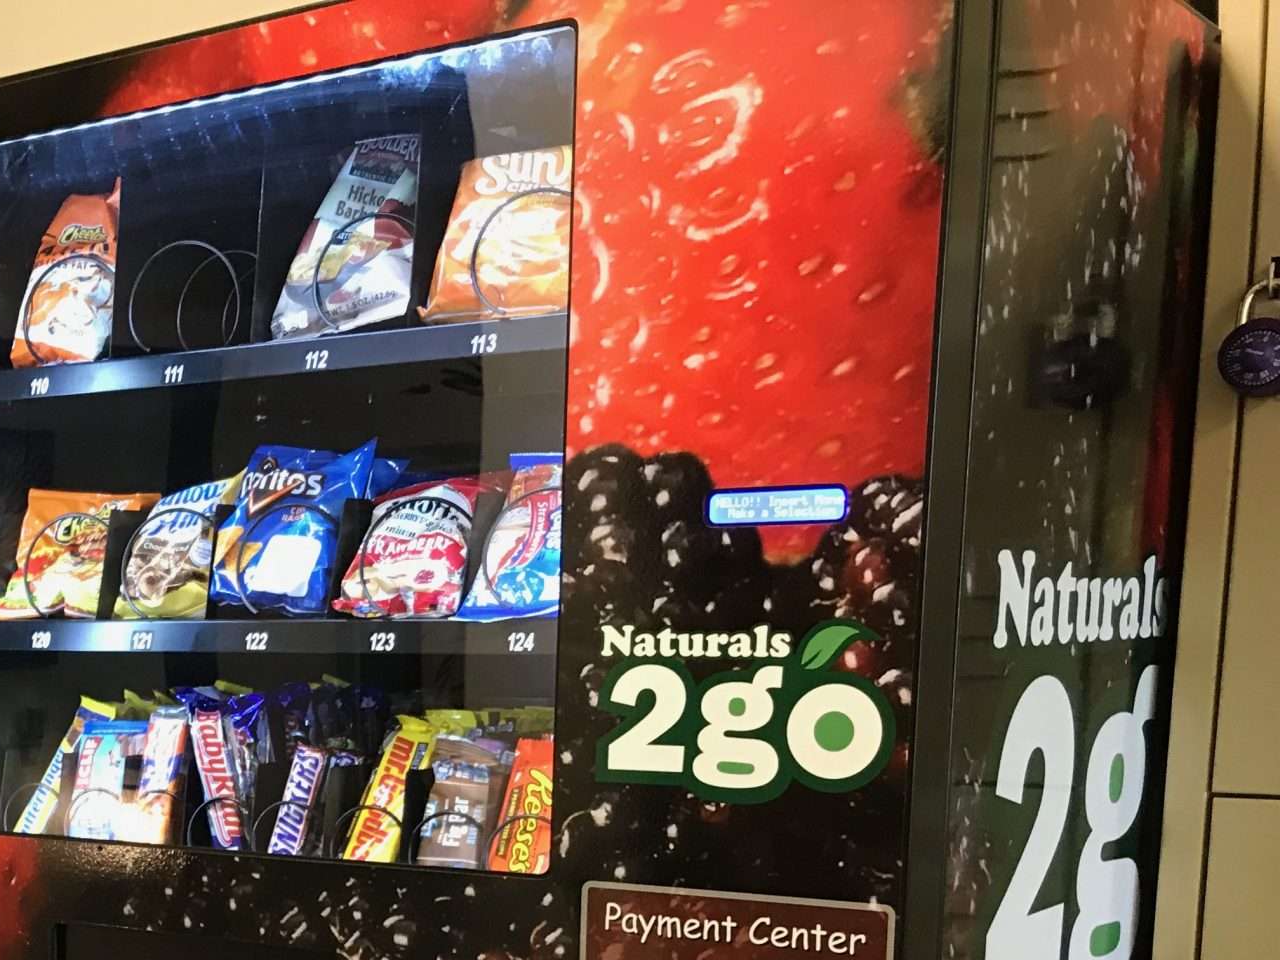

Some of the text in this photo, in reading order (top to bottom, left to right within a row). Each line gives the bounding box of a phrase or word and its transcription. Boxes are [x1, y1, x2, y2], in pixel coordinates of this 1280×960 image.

[347, 185, 386, 207] Hicko
[470, 333, 497, 354] 113
[304, 350, 329, 370] 112
[164, 364, 184, 384] 111
[30, 377, 49, 396] 110
[31, 631, 51, 649] 120
[131, 632, 152, 650] 121
[245, 632, 268, 650] 122
[369, 632, 396, 651] 123
[507, 632, 535, 652] 124
[600, 624, 792, 658] Naturals
[607, 663, 883, 789] 2go
[509, 768, 554, 874] Reese's
[604, 902, 867, 955] Payment Center
